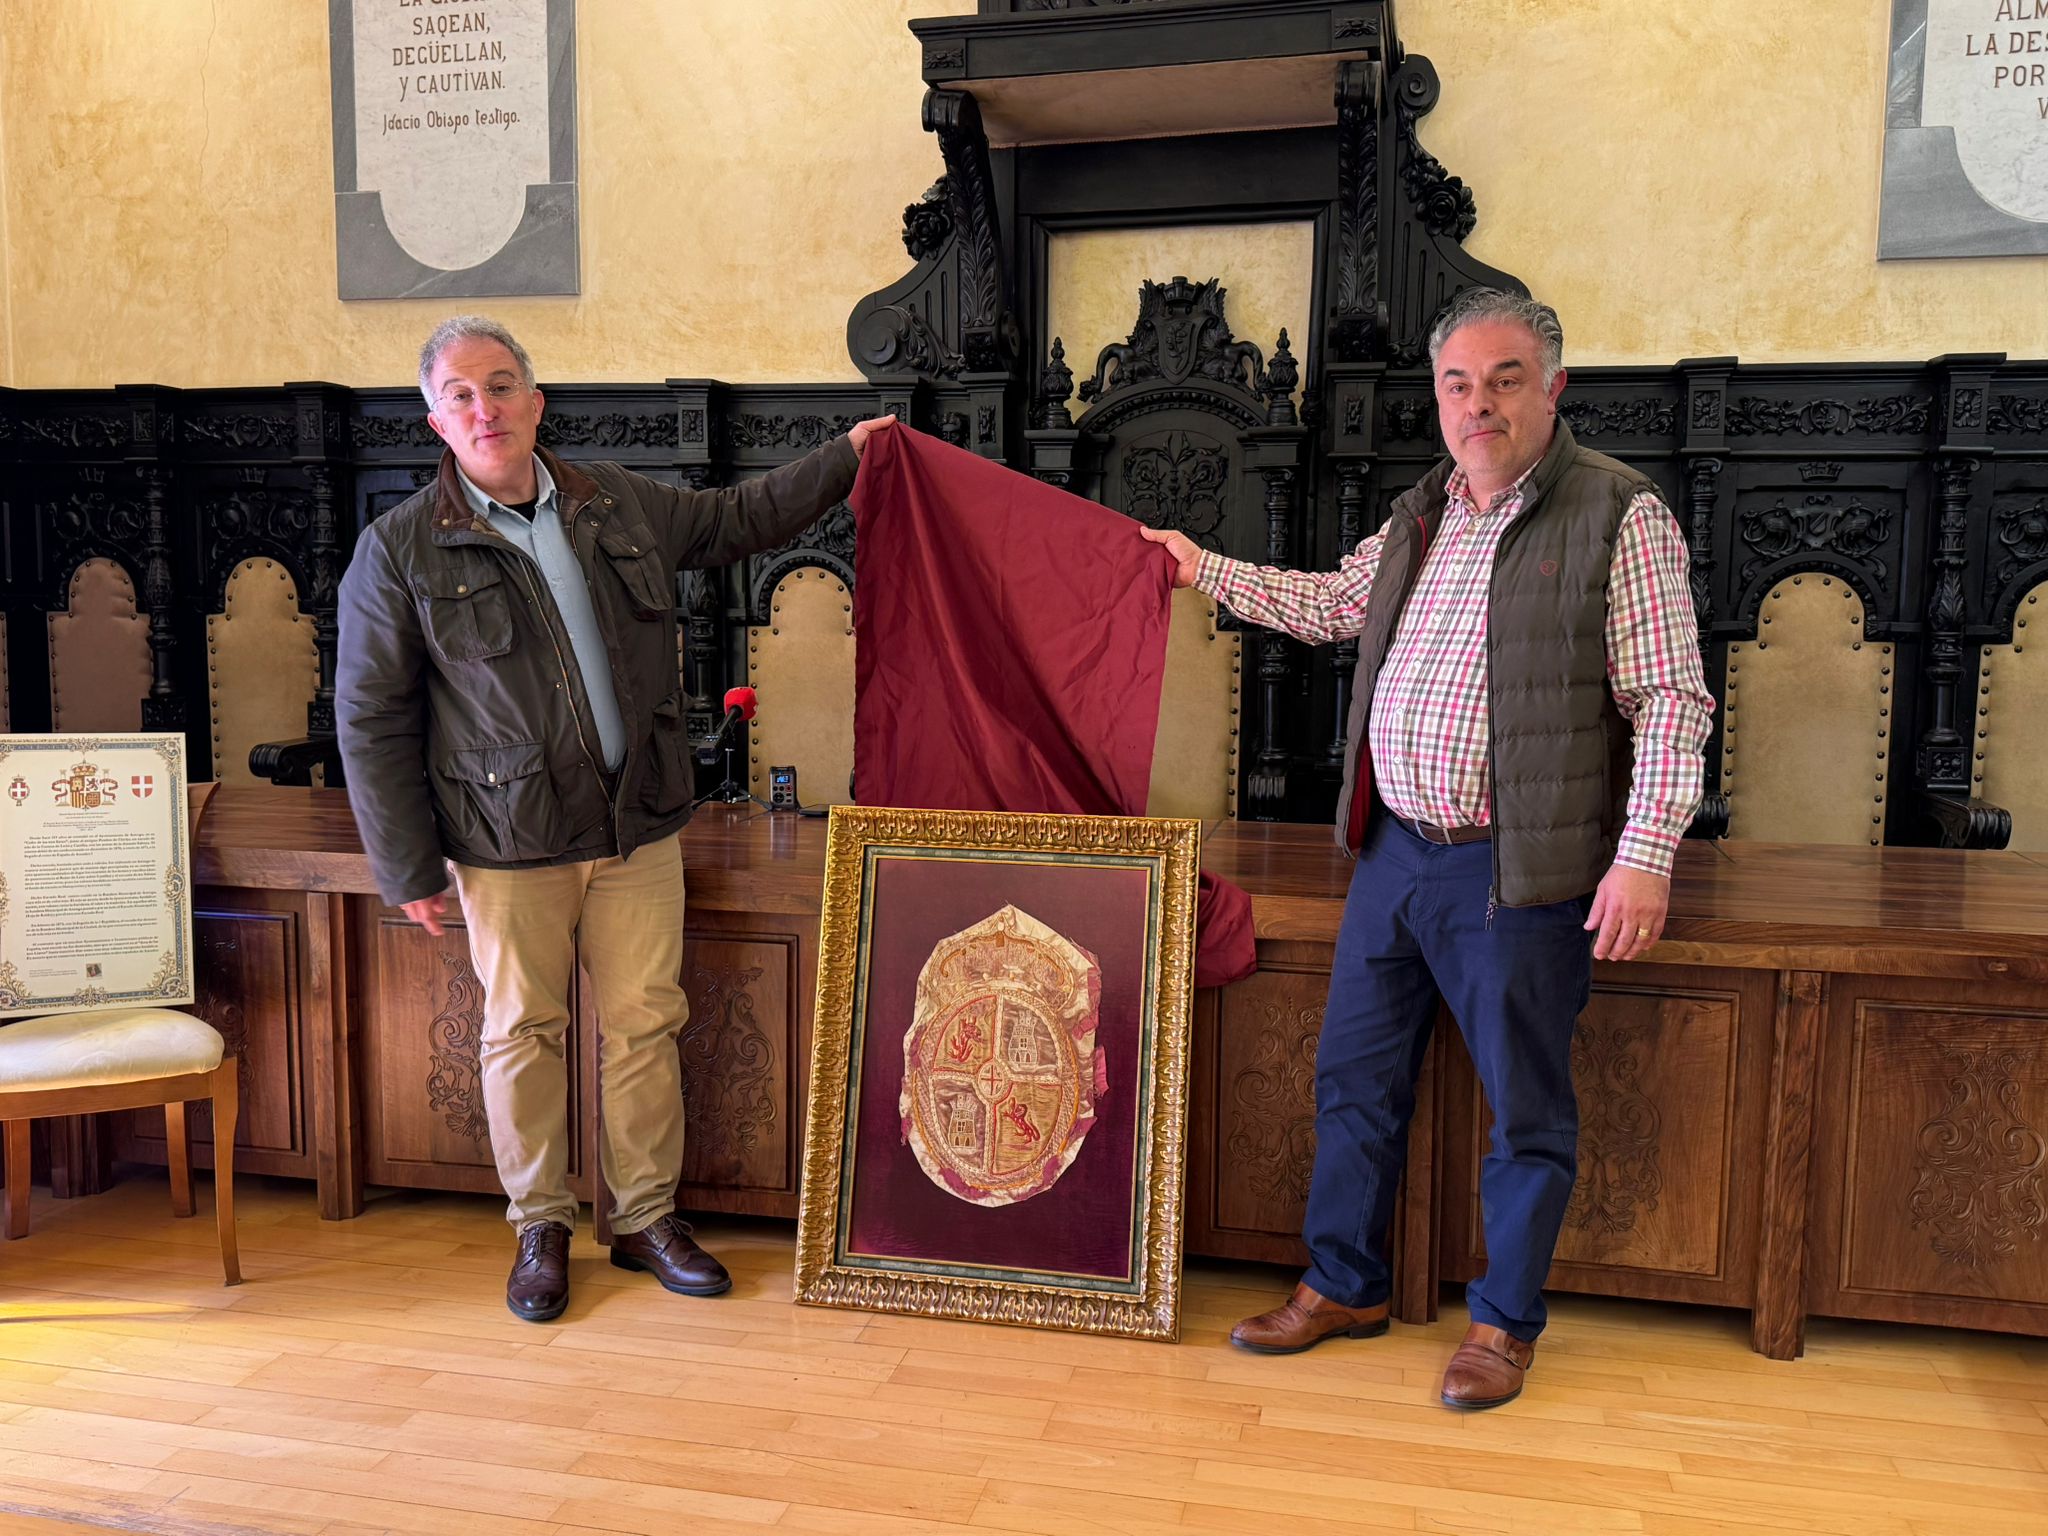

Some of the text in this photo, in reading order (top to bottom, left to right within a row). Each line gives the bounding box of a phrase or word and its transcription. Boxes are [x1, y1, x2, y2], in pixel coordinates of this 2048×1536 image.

[392, 40, 506, 66] DEGÜELLAN,
[1966, 31, 2048, 56] LA DE
[417, 69, 506, 94] CAUTIVAN.
[1994, 64, 2045, 88] POR
[427, 110, 469, 134] Obispo
